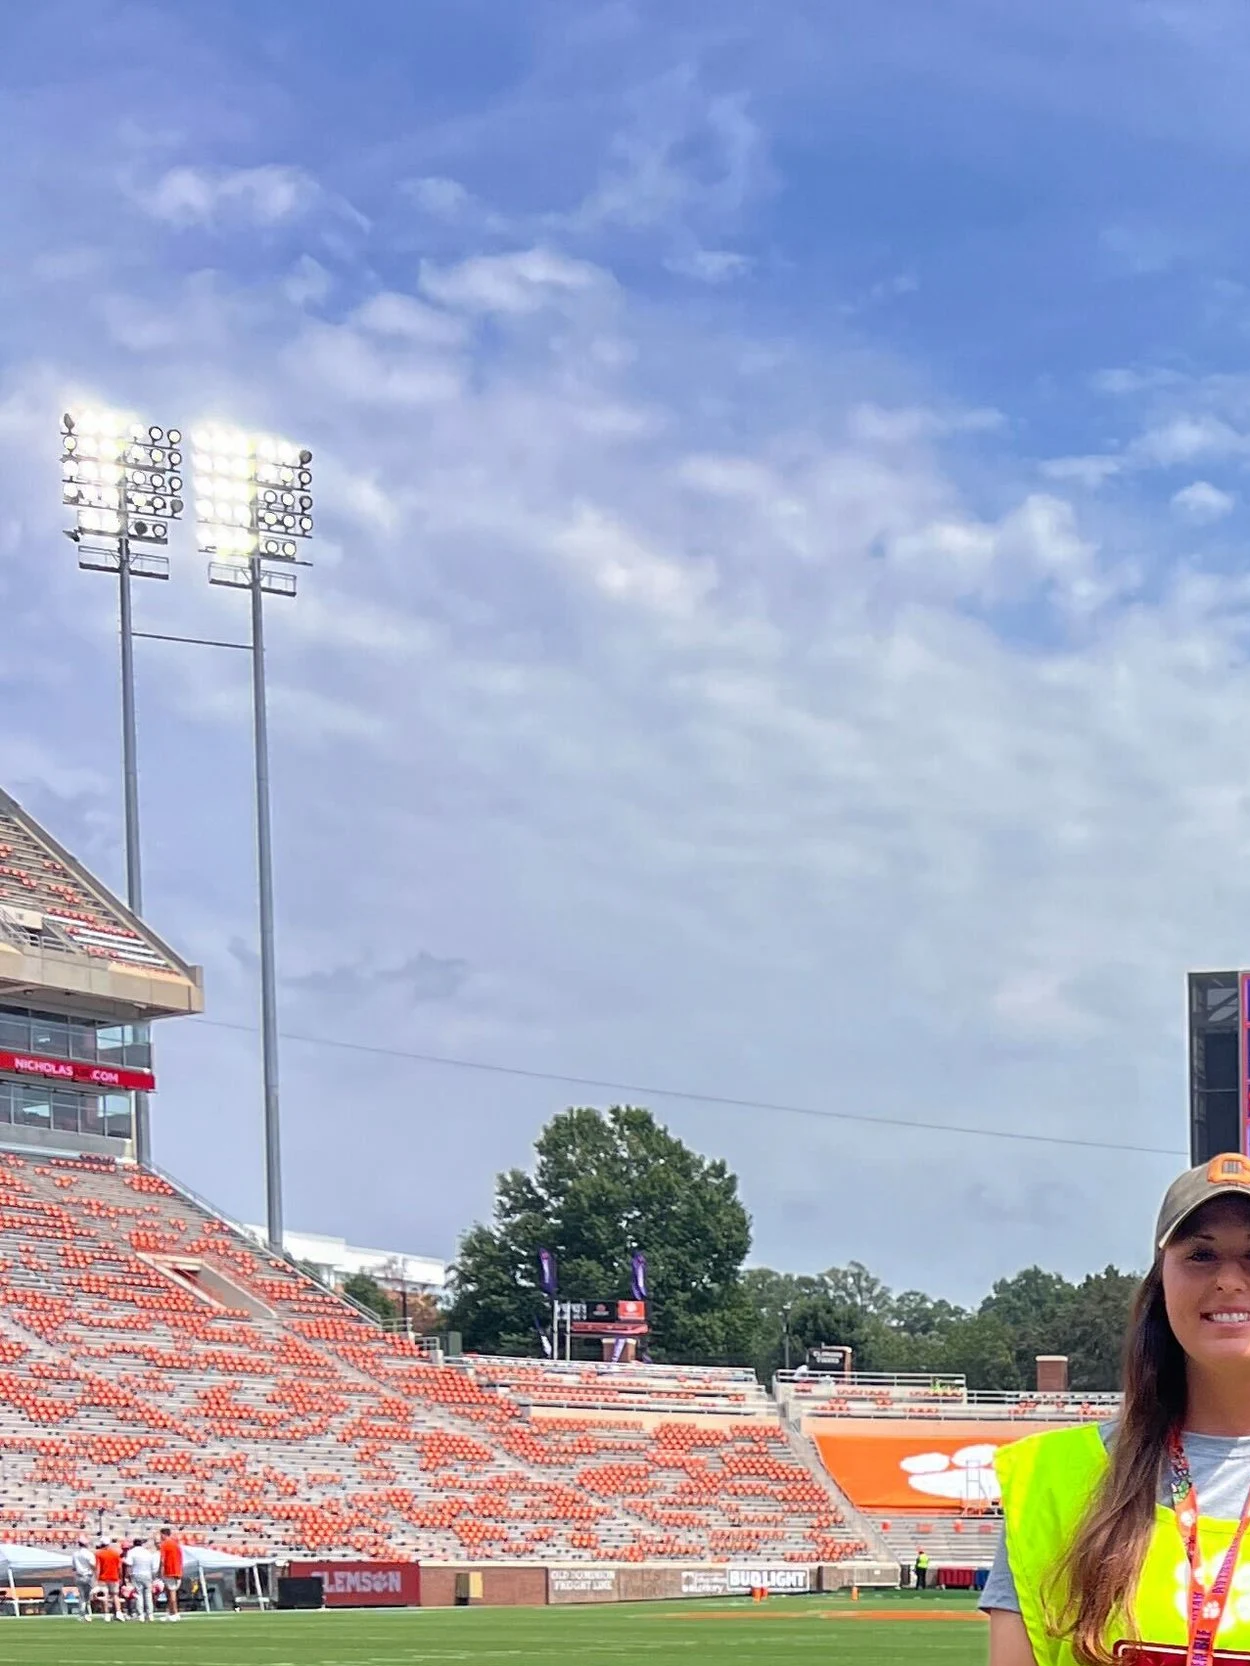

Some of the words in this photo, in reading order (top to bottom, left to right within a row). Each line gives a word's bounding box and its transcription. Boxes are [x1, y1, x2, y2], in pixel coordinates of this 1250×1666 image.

[14, 1058, 74, 1077] NICHOLAS
[730, 1571, 760, 1588] BUD
[761, 1570, 806, 1589] LIGHT
